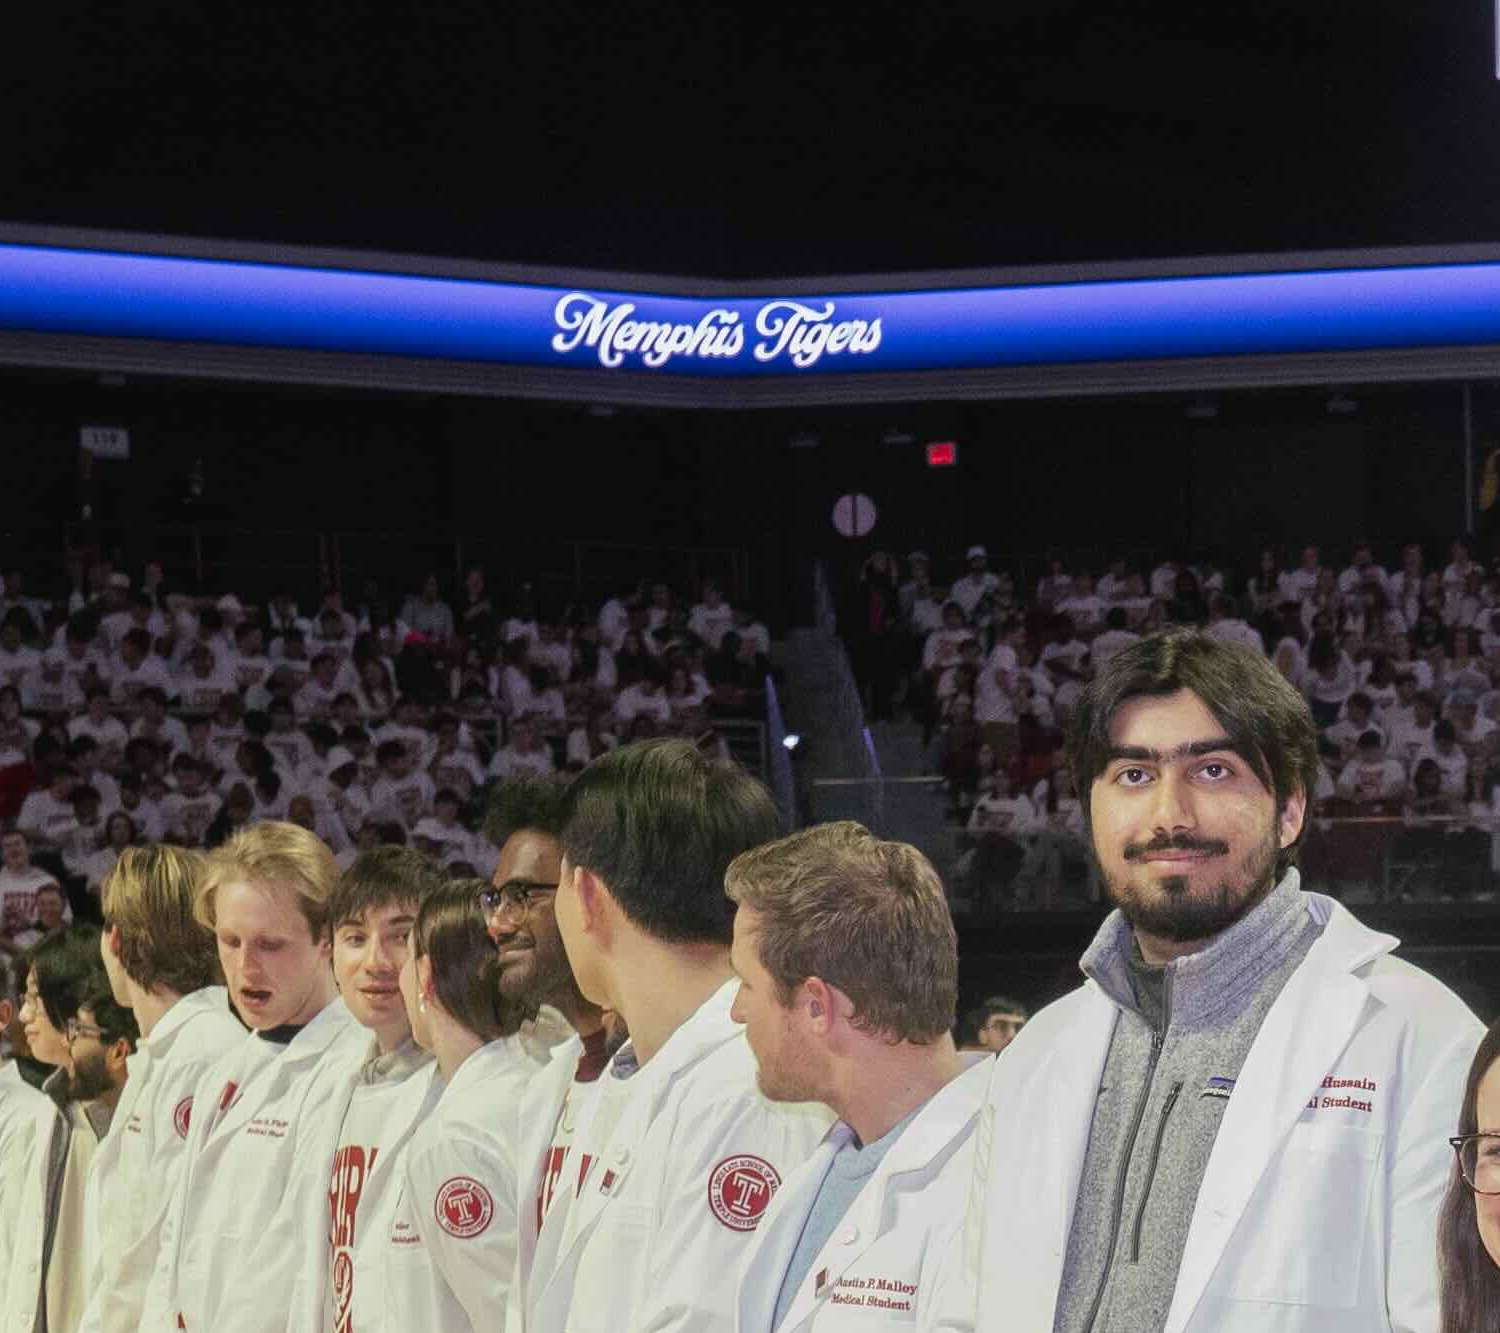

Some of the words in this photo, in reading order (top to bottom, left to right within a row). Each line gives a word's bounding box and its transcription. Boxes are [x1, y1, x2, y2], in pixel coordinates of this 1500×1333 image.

[552, 292, 745, 367] Memphis
[753, 299, 883, 368] Tigers
[1321, 1075, 1377, 1092] Hussain
[1322, 1096, 1373, 1112] Student
[876, 1279, 918, 1295] Malloy
[831, 1293, 865, 1306] Medical
[866, 1296, 911, 1311] Student
